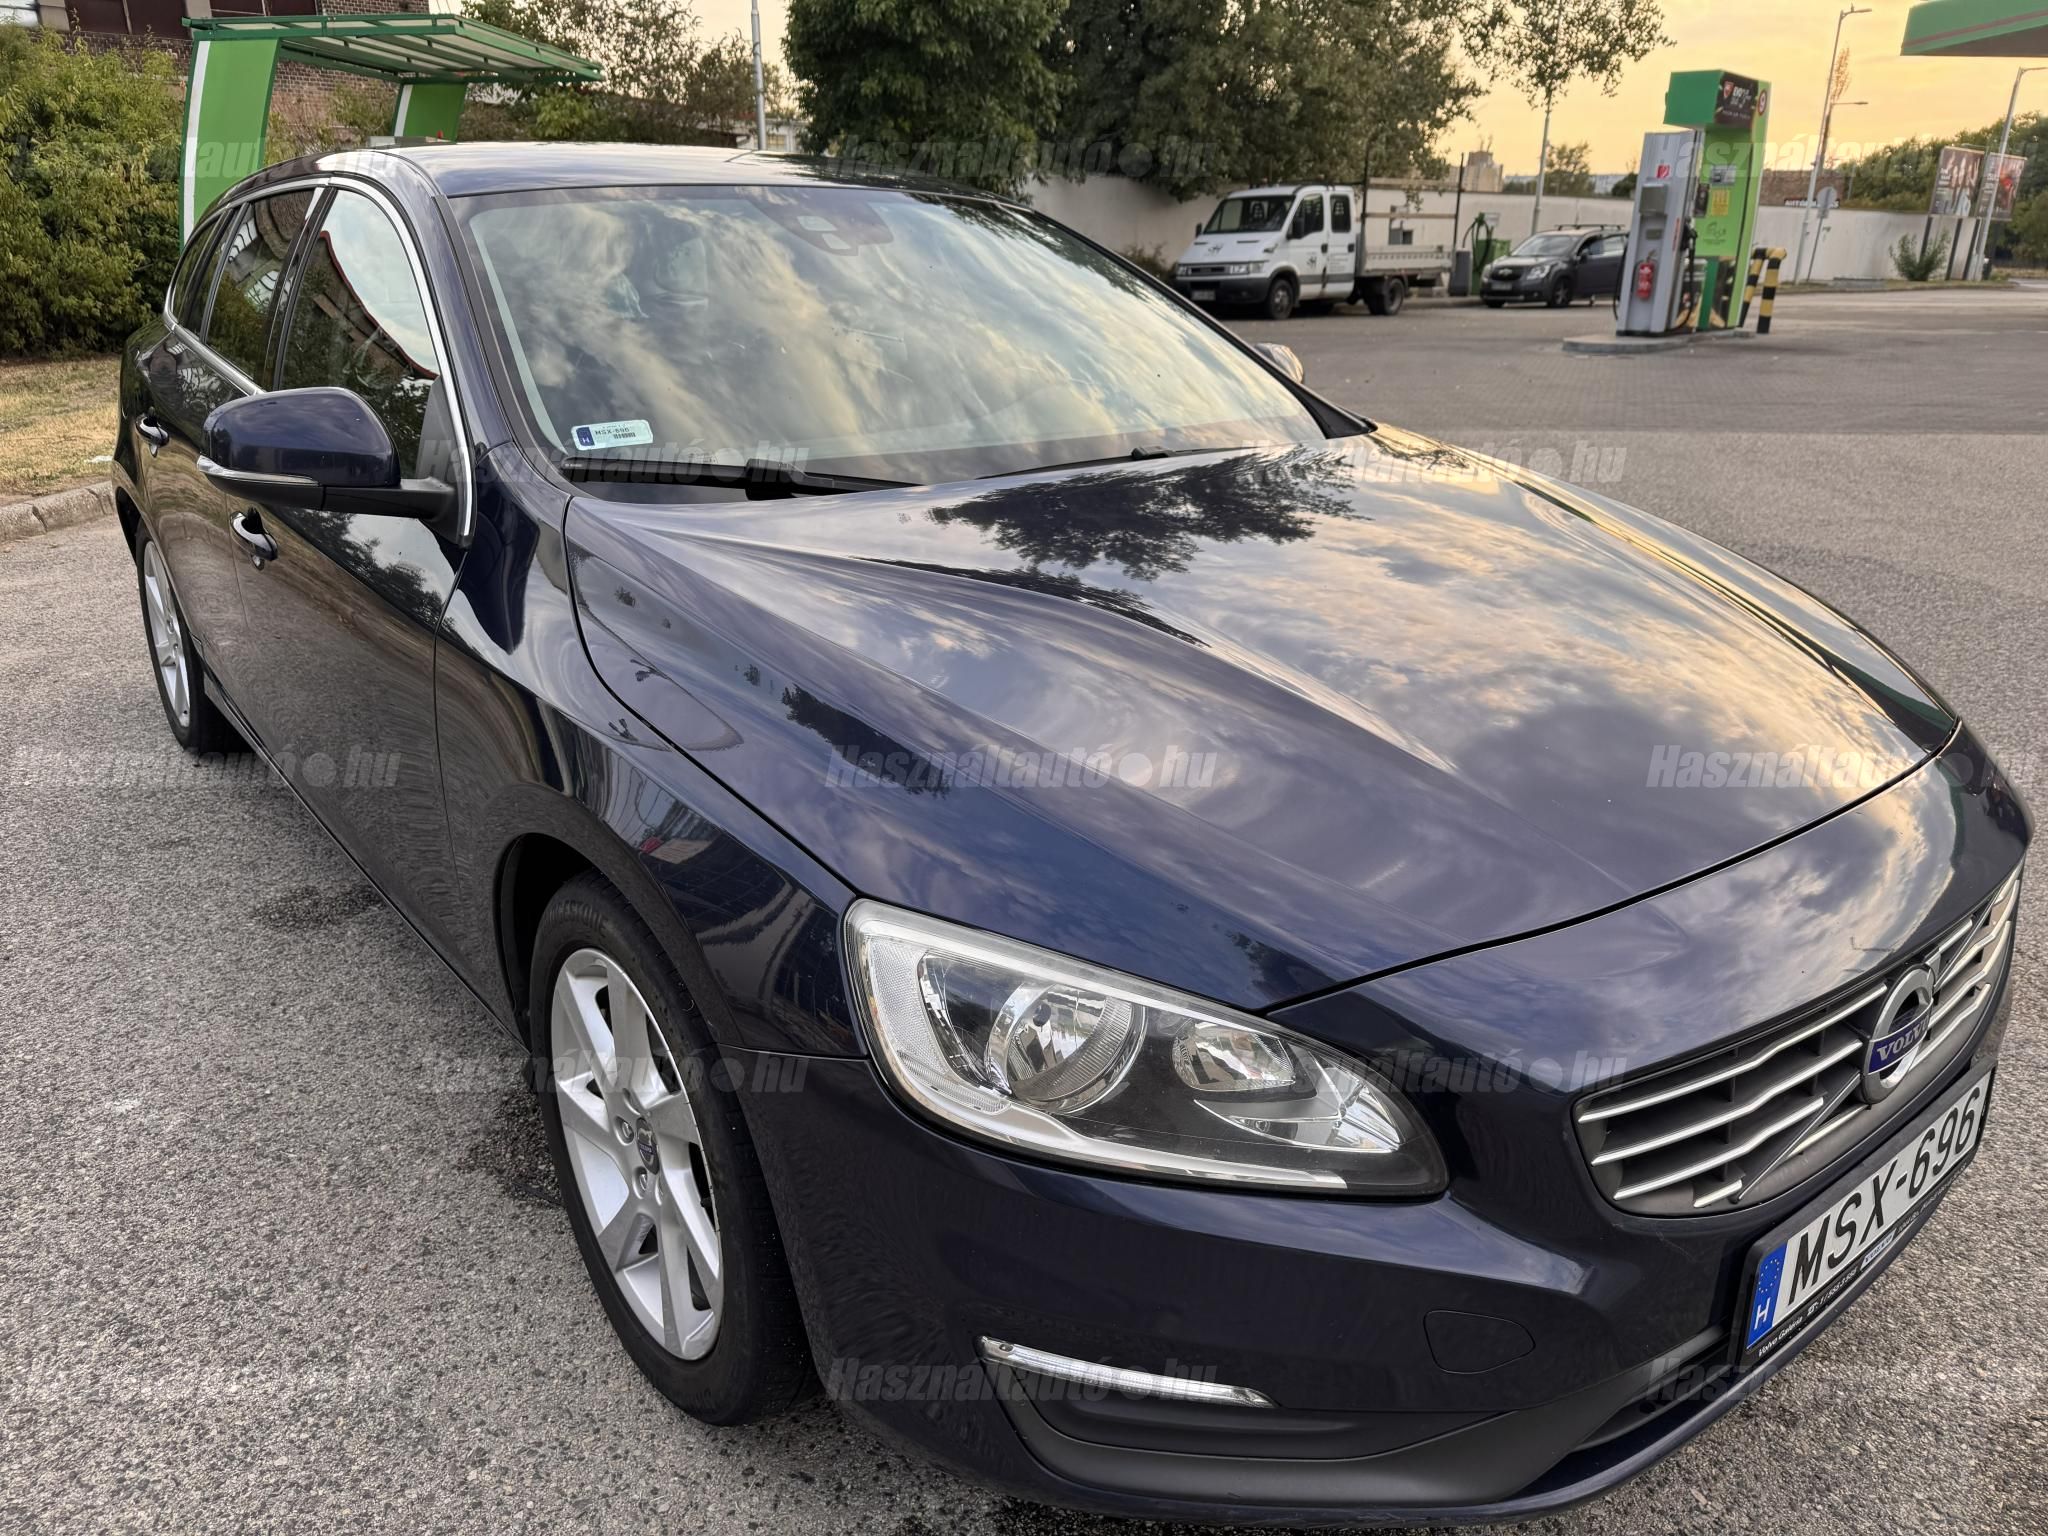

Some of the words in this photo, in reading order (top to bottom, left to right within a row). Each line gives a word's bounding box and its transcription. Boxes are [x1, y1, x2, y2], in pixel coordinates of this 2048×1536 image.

[1876, 1014, 1929, 1061] VOLVO
[1787, 1086, 1980, 1306] MSX-696
[1754, 1297, 1771, 1330] H
